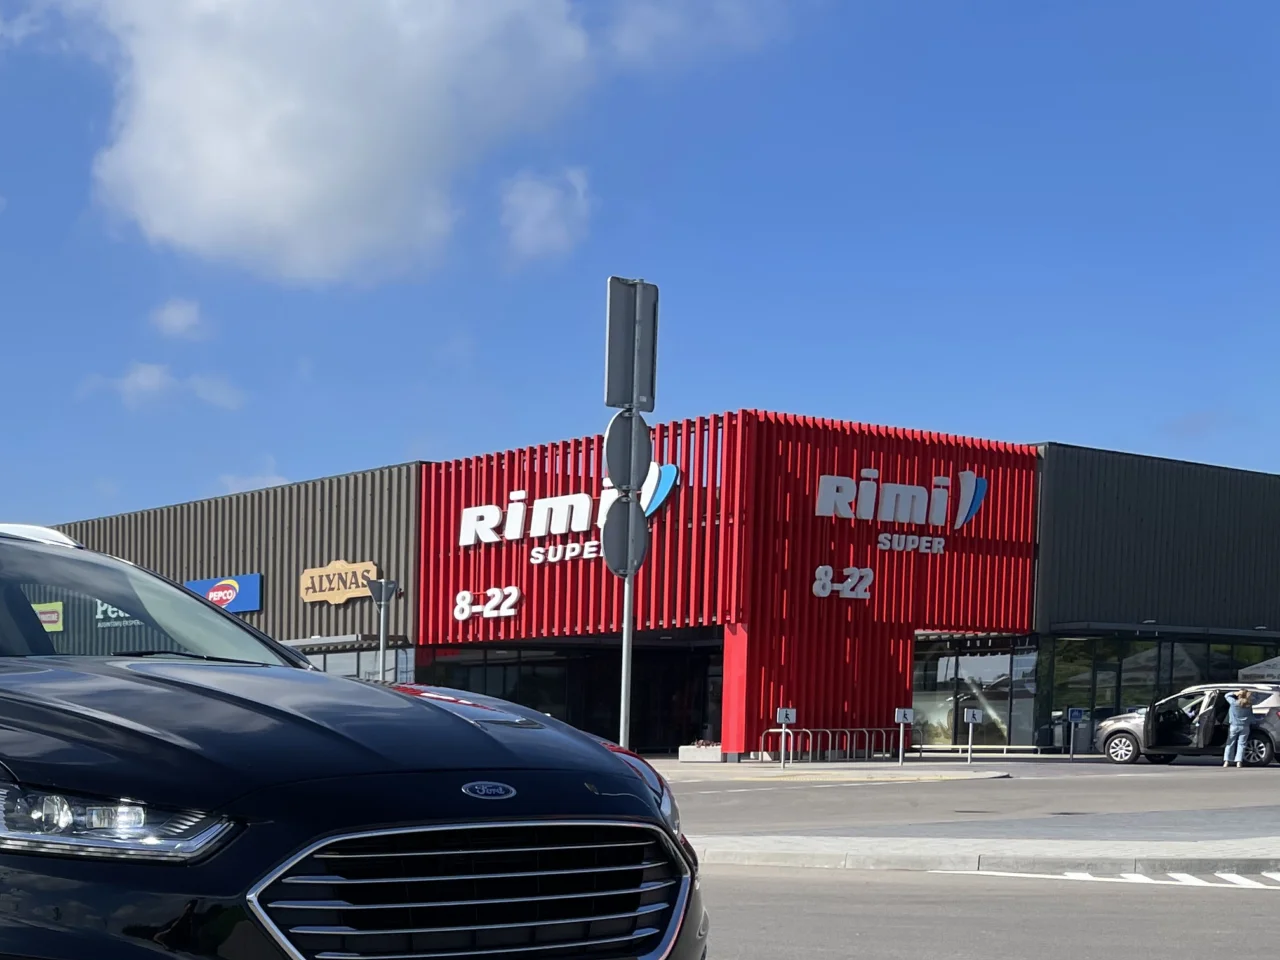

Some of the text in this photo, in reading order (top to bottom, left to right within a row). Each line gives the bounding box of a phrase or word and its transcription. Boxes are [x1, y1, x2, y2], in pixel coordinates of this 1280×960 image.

[815, 468, 950, 526] Rimi
[530, 540, 604, 565] SUPE
[877, 533, 946, 554] SUPER
[305, 569, 371, 595] ALYNAS
[812, 565, 874, 599] 8-22
[208, 590, 234, 601] PEPCO
[453, 586, 521, 621] 8-22
[475, 785, 505, 795] Ford
